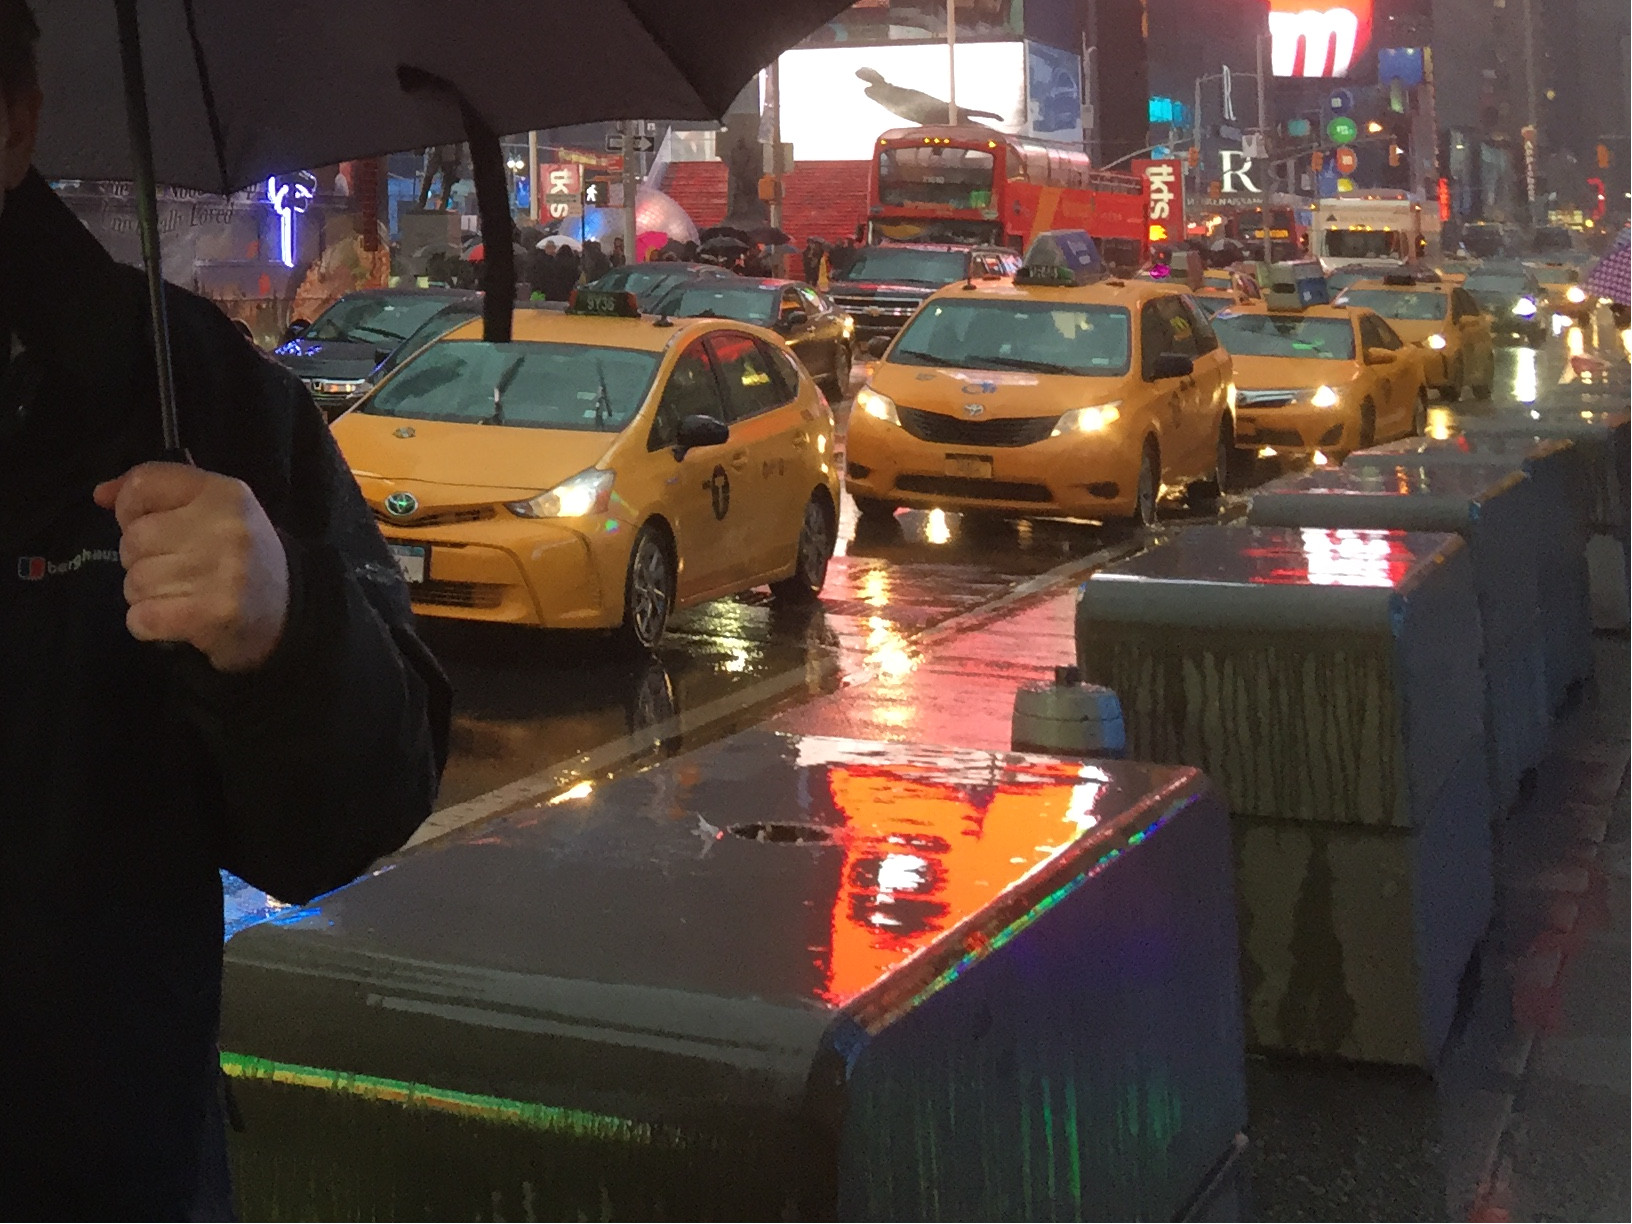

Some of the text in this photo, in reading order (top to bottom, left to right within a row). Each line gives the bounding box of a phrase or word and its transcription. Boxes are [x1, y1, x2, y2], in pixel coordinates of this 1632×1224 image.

[549, 167, 570, 217] tks
[1145, 163, 1176, 220] tkts
[1219, 150, 1263, 193] R
